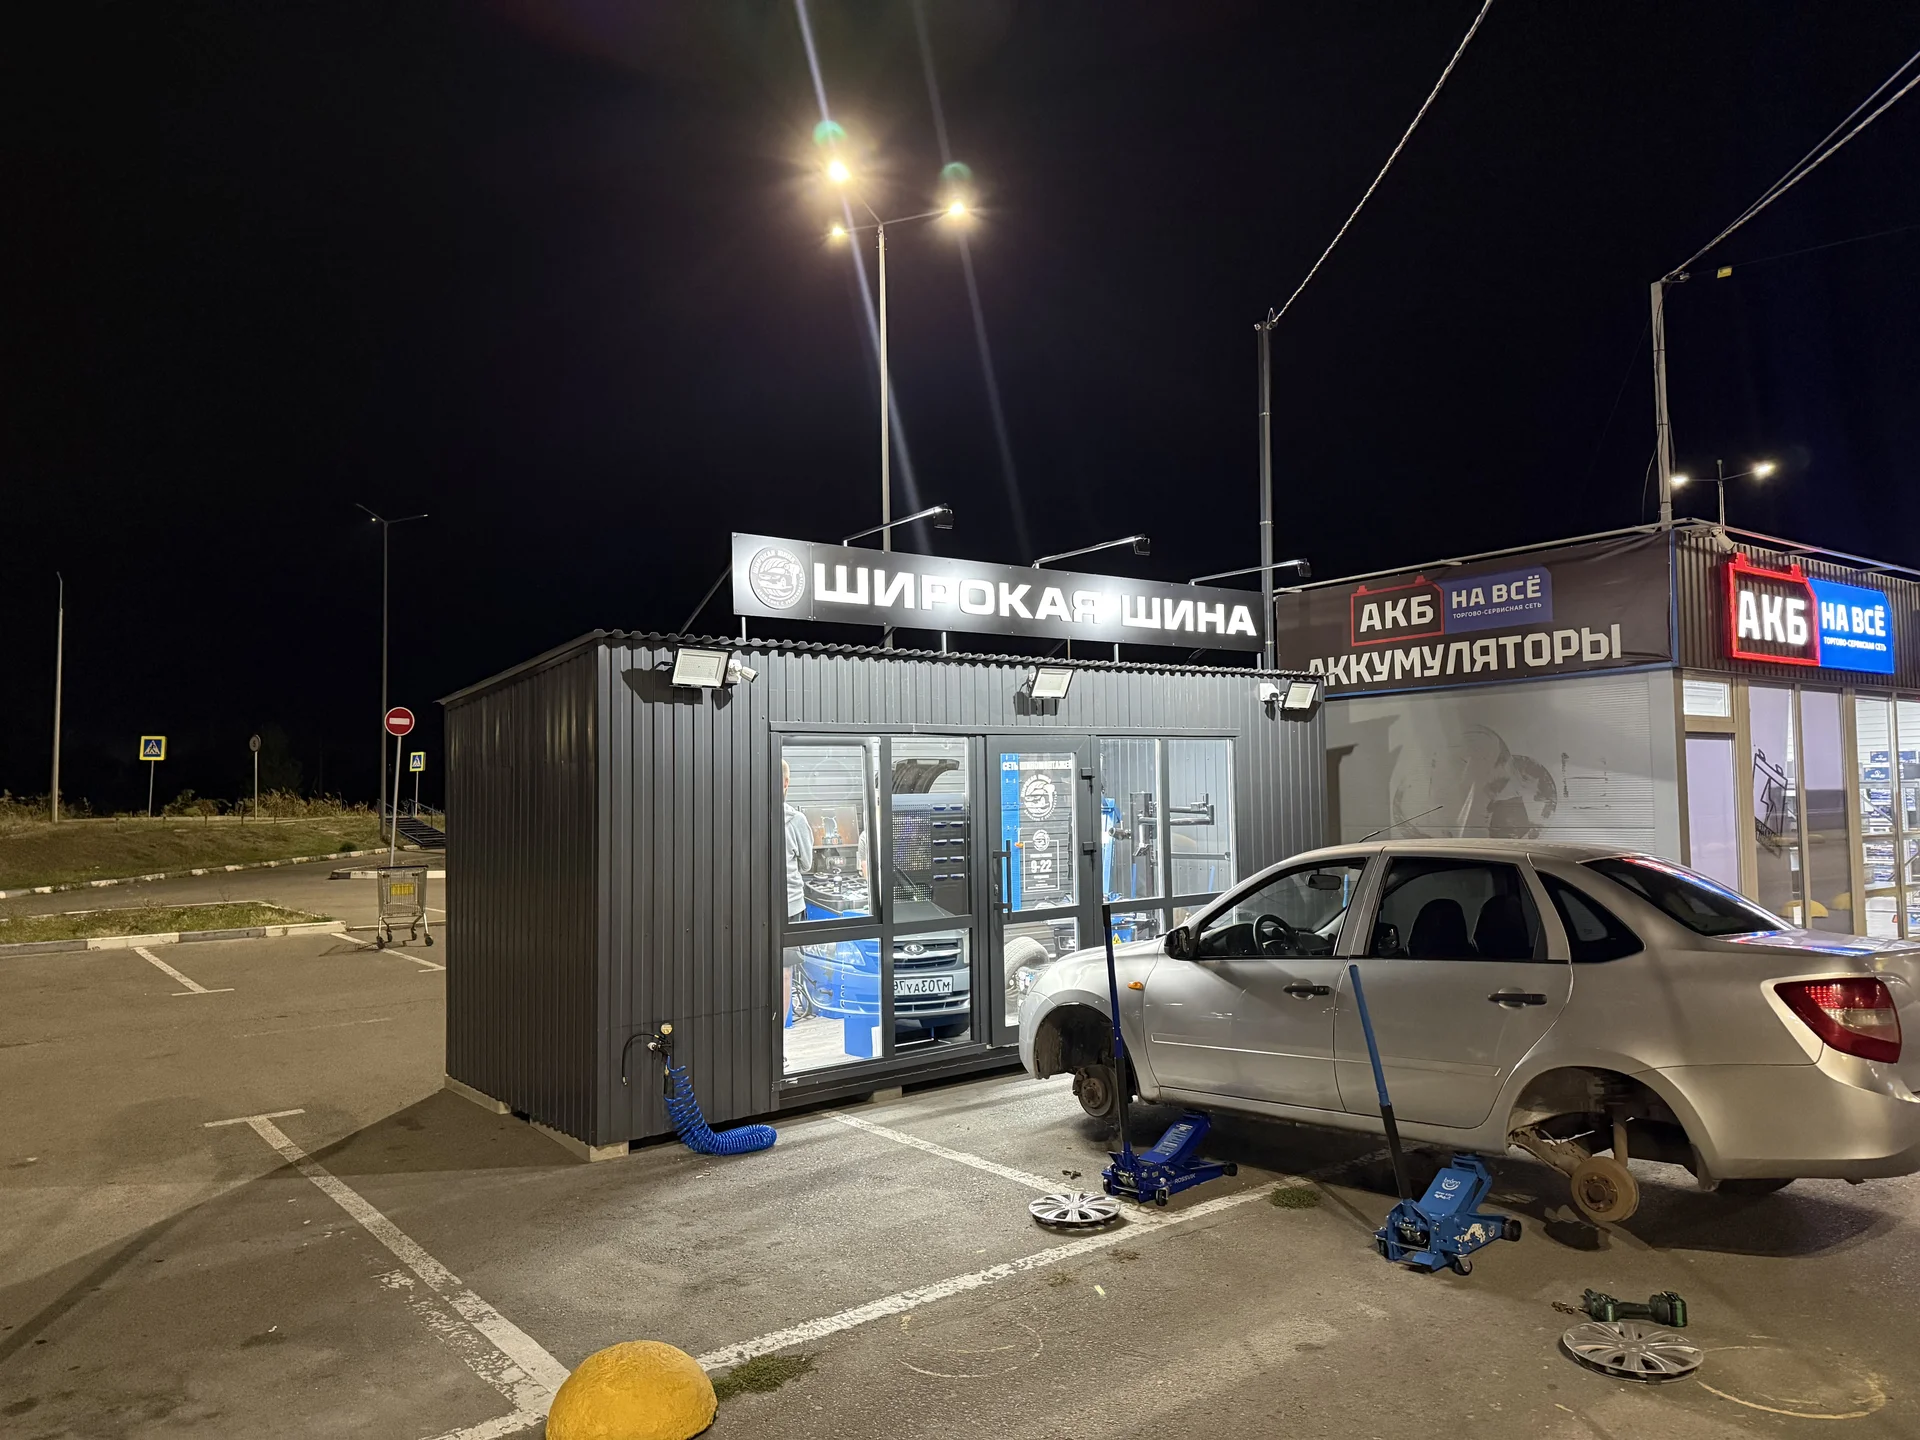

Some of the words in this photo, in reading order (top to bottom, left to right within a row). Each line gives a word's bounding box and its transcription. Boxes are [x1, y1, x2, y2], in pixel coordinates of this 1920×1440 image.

[813, 562, 1102, 624] ШИРОКАЯ
[1120, 594, 1258, 637] ШИНА
[1359, 594, 1435, 633] АКБ
[1451, 587, 1486, 609] НА
[1492, 574, 1542, 604] ВСЁ
[1452, 604, 1523, 619] ТОРГОВО-СЕРВИСНАЯ
[1524, 602, 1542, 610] СЕТЬ
[1738, 590, 1809, 646] АКБ
[1821, 601, 1850, 632] НА
[1851, 604, 1887, 637] ВСЁ
[1308, 623, 1622, 687] АККУМУЛЯТОРЫ
[1002, 761, 1019, 771] СЕТЬ
